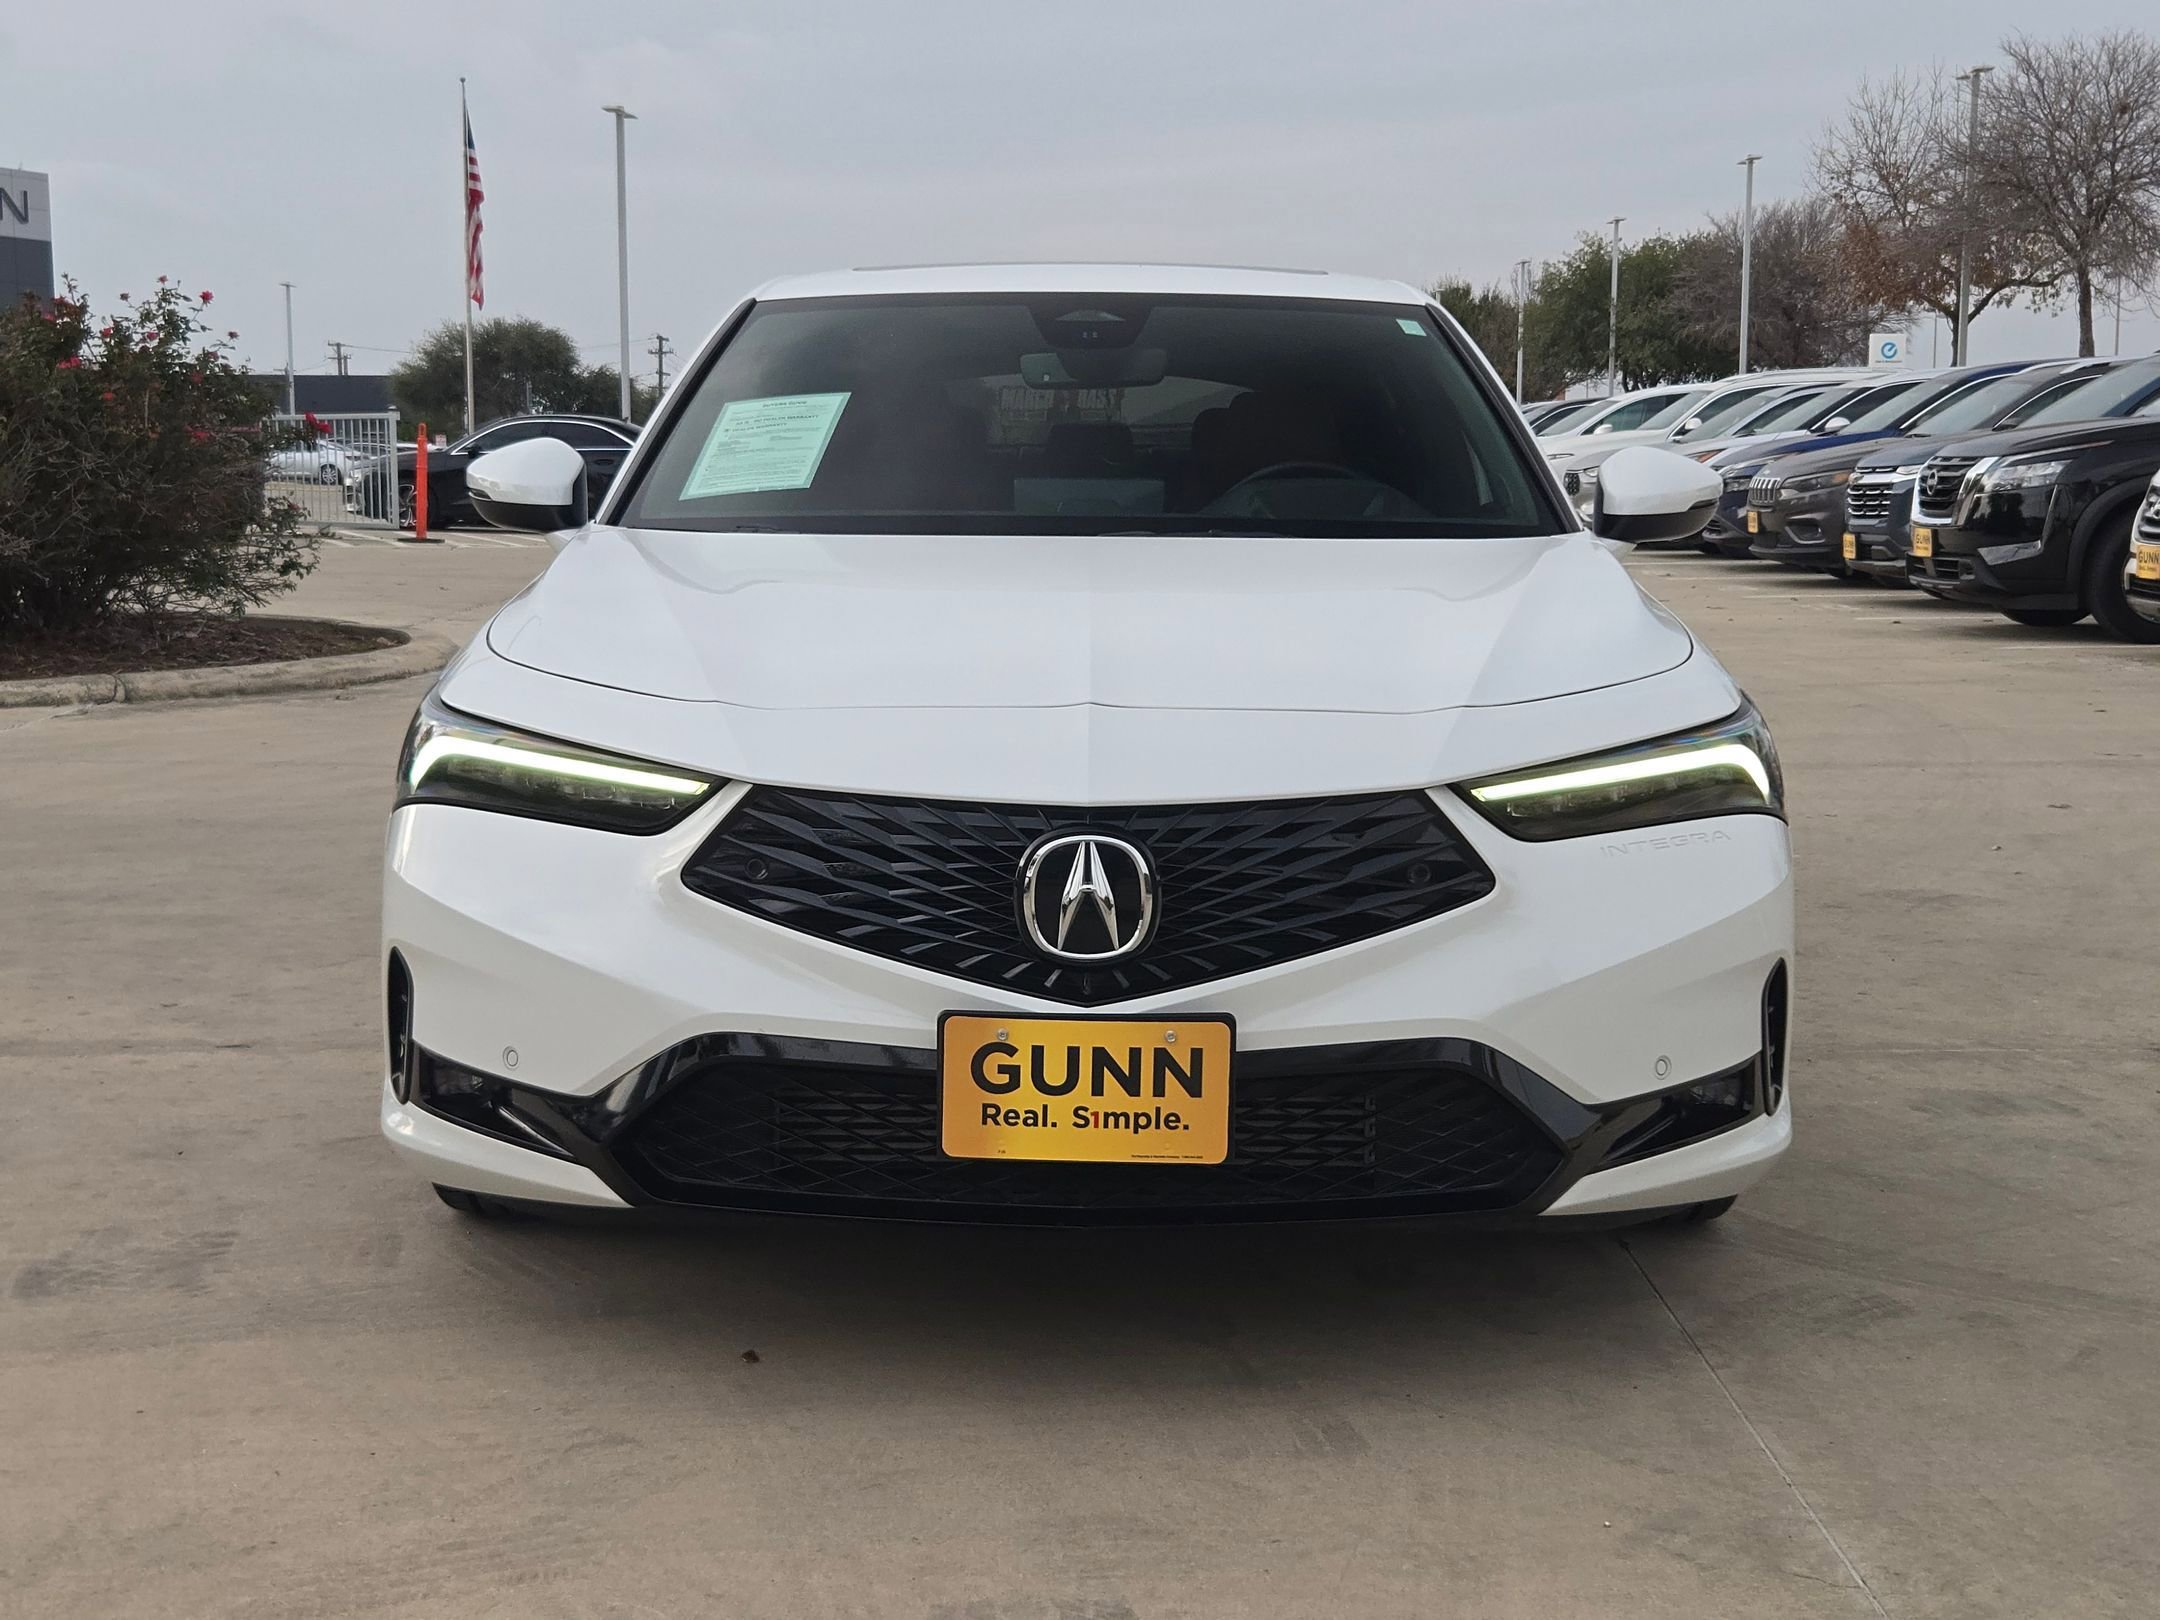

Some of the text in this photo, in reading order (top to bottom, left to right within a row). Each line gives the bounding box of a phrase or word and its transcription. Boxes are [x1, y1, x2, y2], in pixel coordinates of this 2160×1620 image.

[1600, 830, 1731, 858] INTEGRA
[970, 1041, 1203, 1098] GUNN
[981, 1103, 1190, 1135] Real. S1mple.
